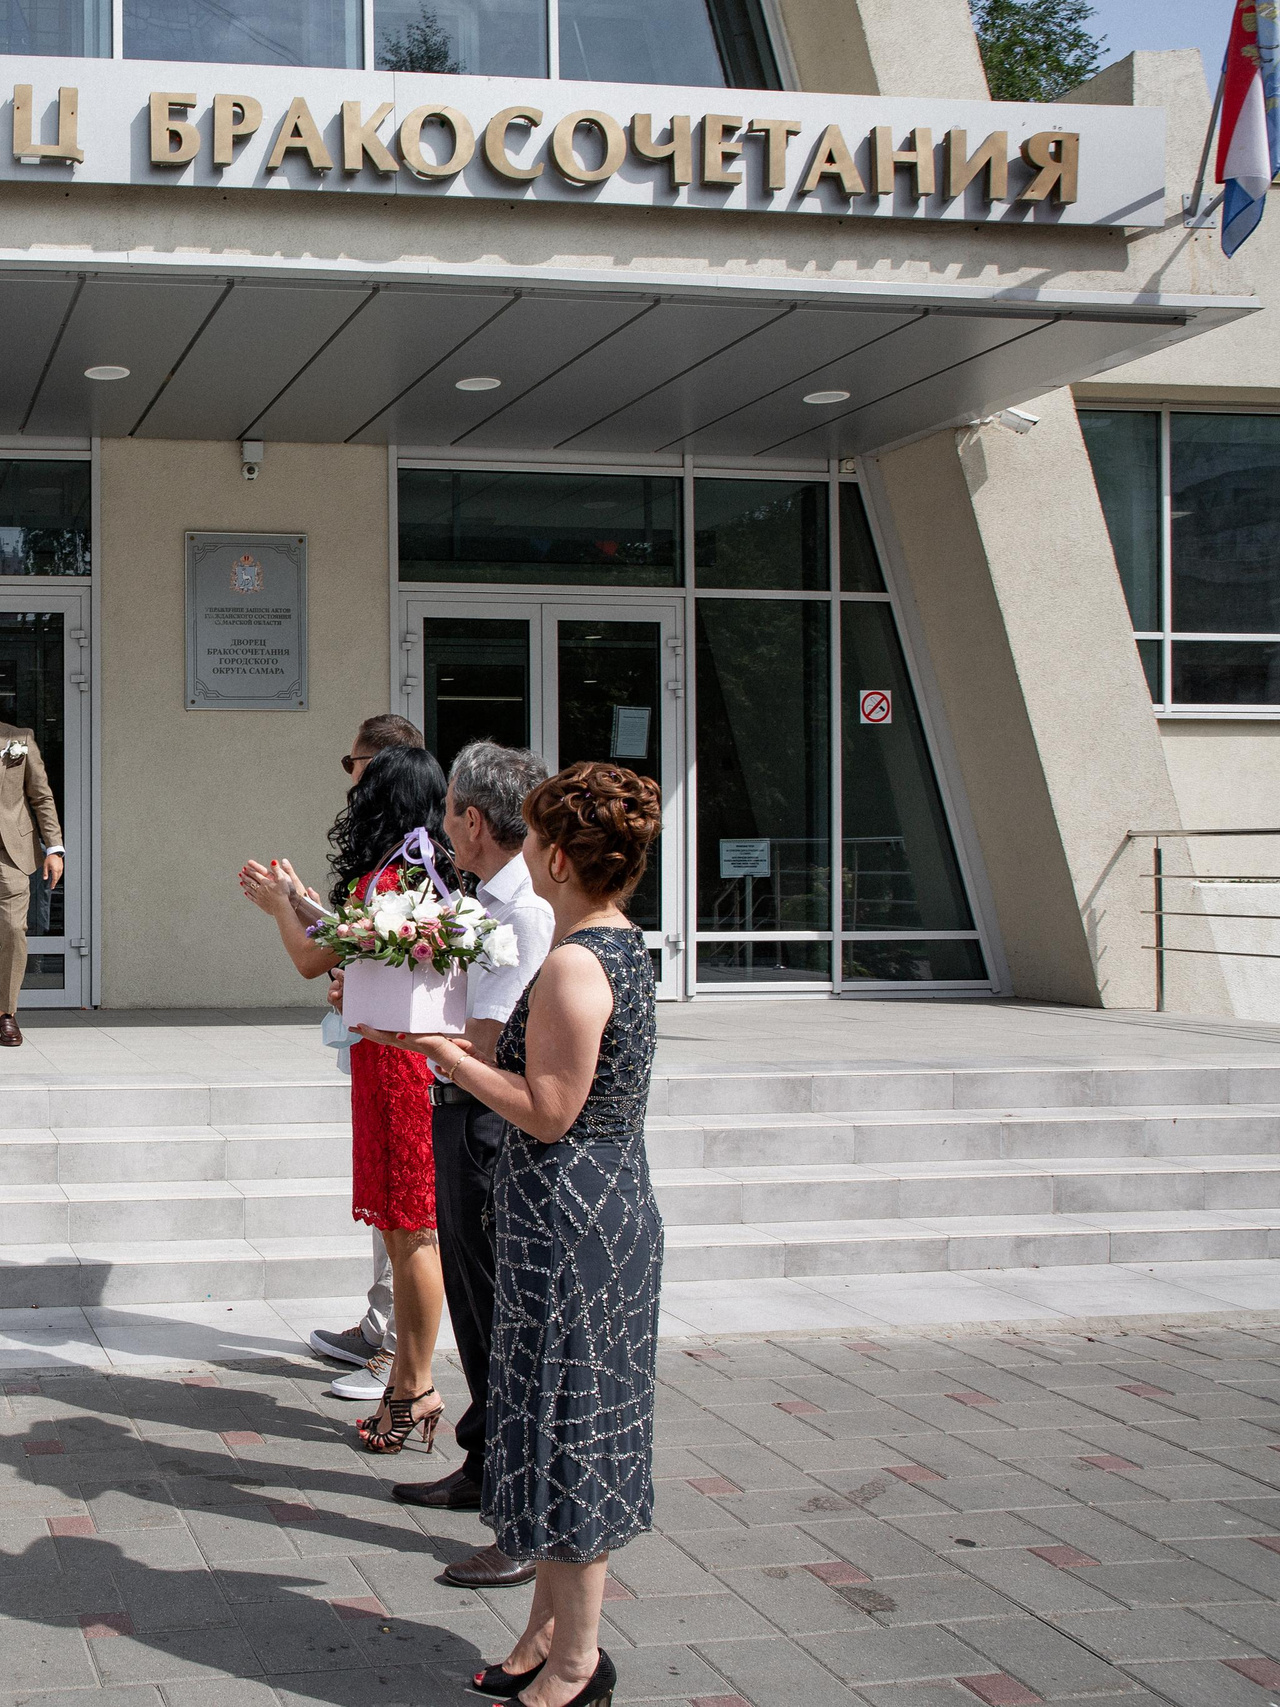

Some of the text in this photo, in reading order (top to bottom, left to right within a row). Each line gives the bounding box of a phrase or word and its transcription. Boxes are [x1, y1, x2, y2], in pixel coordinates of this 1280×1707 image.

[149, 92, 1080, 205] БРАКОСОЧЕТАНИЯ
[230, 638, 266, 647] ДВОРЕЦ
[207, 648, 290, 656] БРАКОСОЧЕТАНИЯ
[219, 657, 279, 666] ГОРОДСКОГО
[212, 666, 285, 675] ОКРУГА САМАРА
